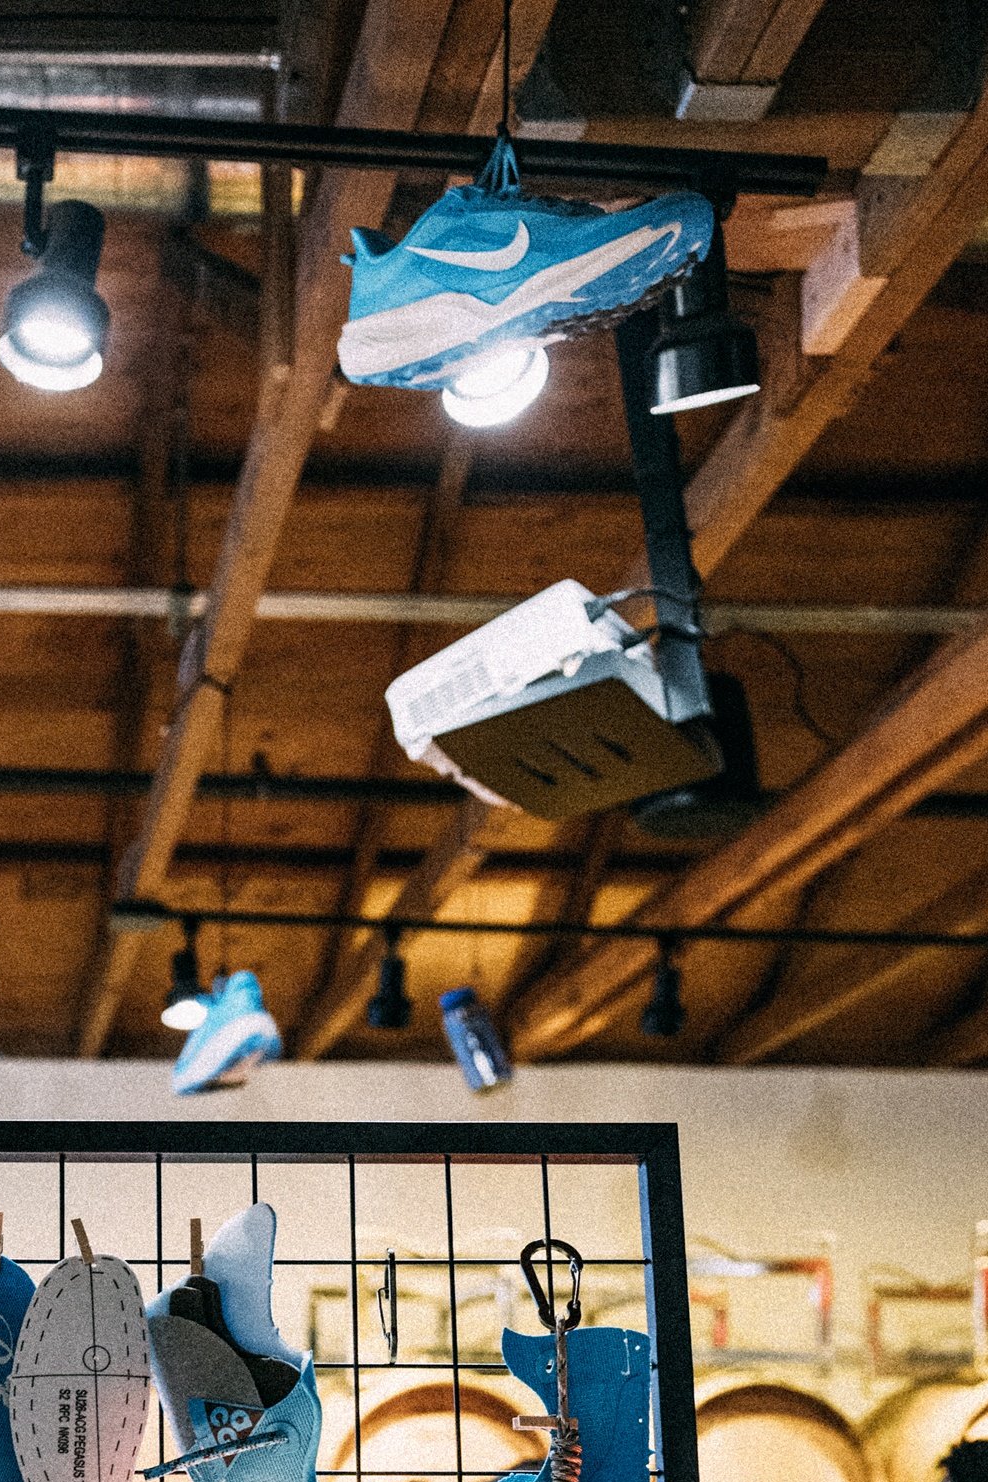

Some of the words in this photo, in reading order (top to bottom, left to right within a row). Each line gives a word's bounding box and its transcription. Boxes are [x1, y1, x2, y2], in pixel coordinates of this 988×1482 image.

[59, 1389, 71, 1401] S2
[58, 1404, 70, 1423] RFC
[73, 1435, 86, 1479] PEGASUS
